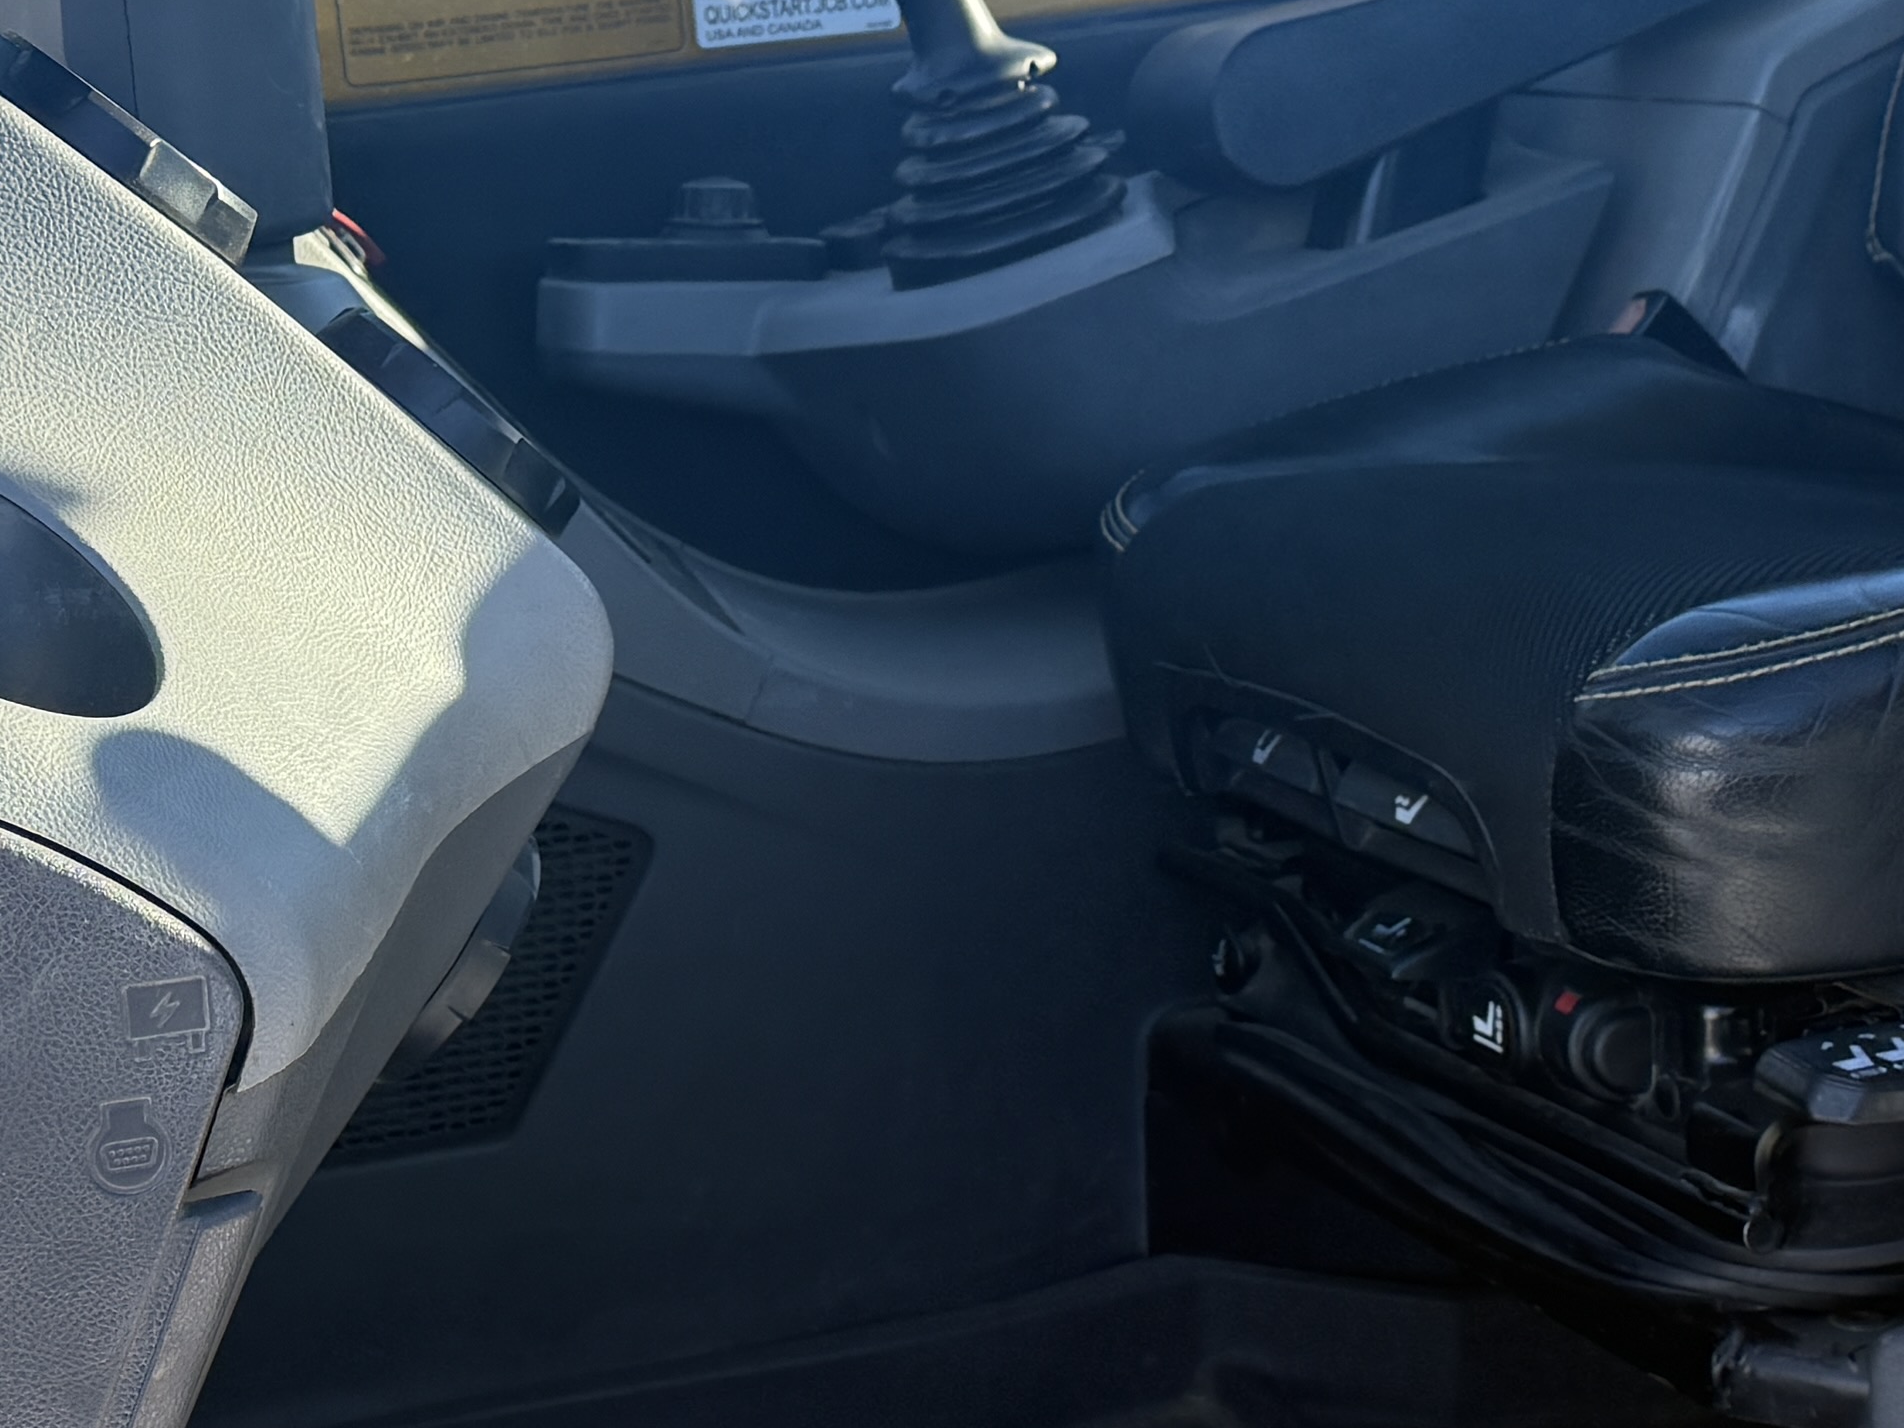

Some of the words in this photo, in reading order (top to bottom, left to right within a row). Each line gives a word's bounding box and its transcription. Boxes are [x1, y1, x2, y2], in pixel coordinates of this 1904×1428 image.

[705, 29, 733, 42] USA
[737, 25, 764, 38] AND
[767, 20, 823, 35] CANADA
